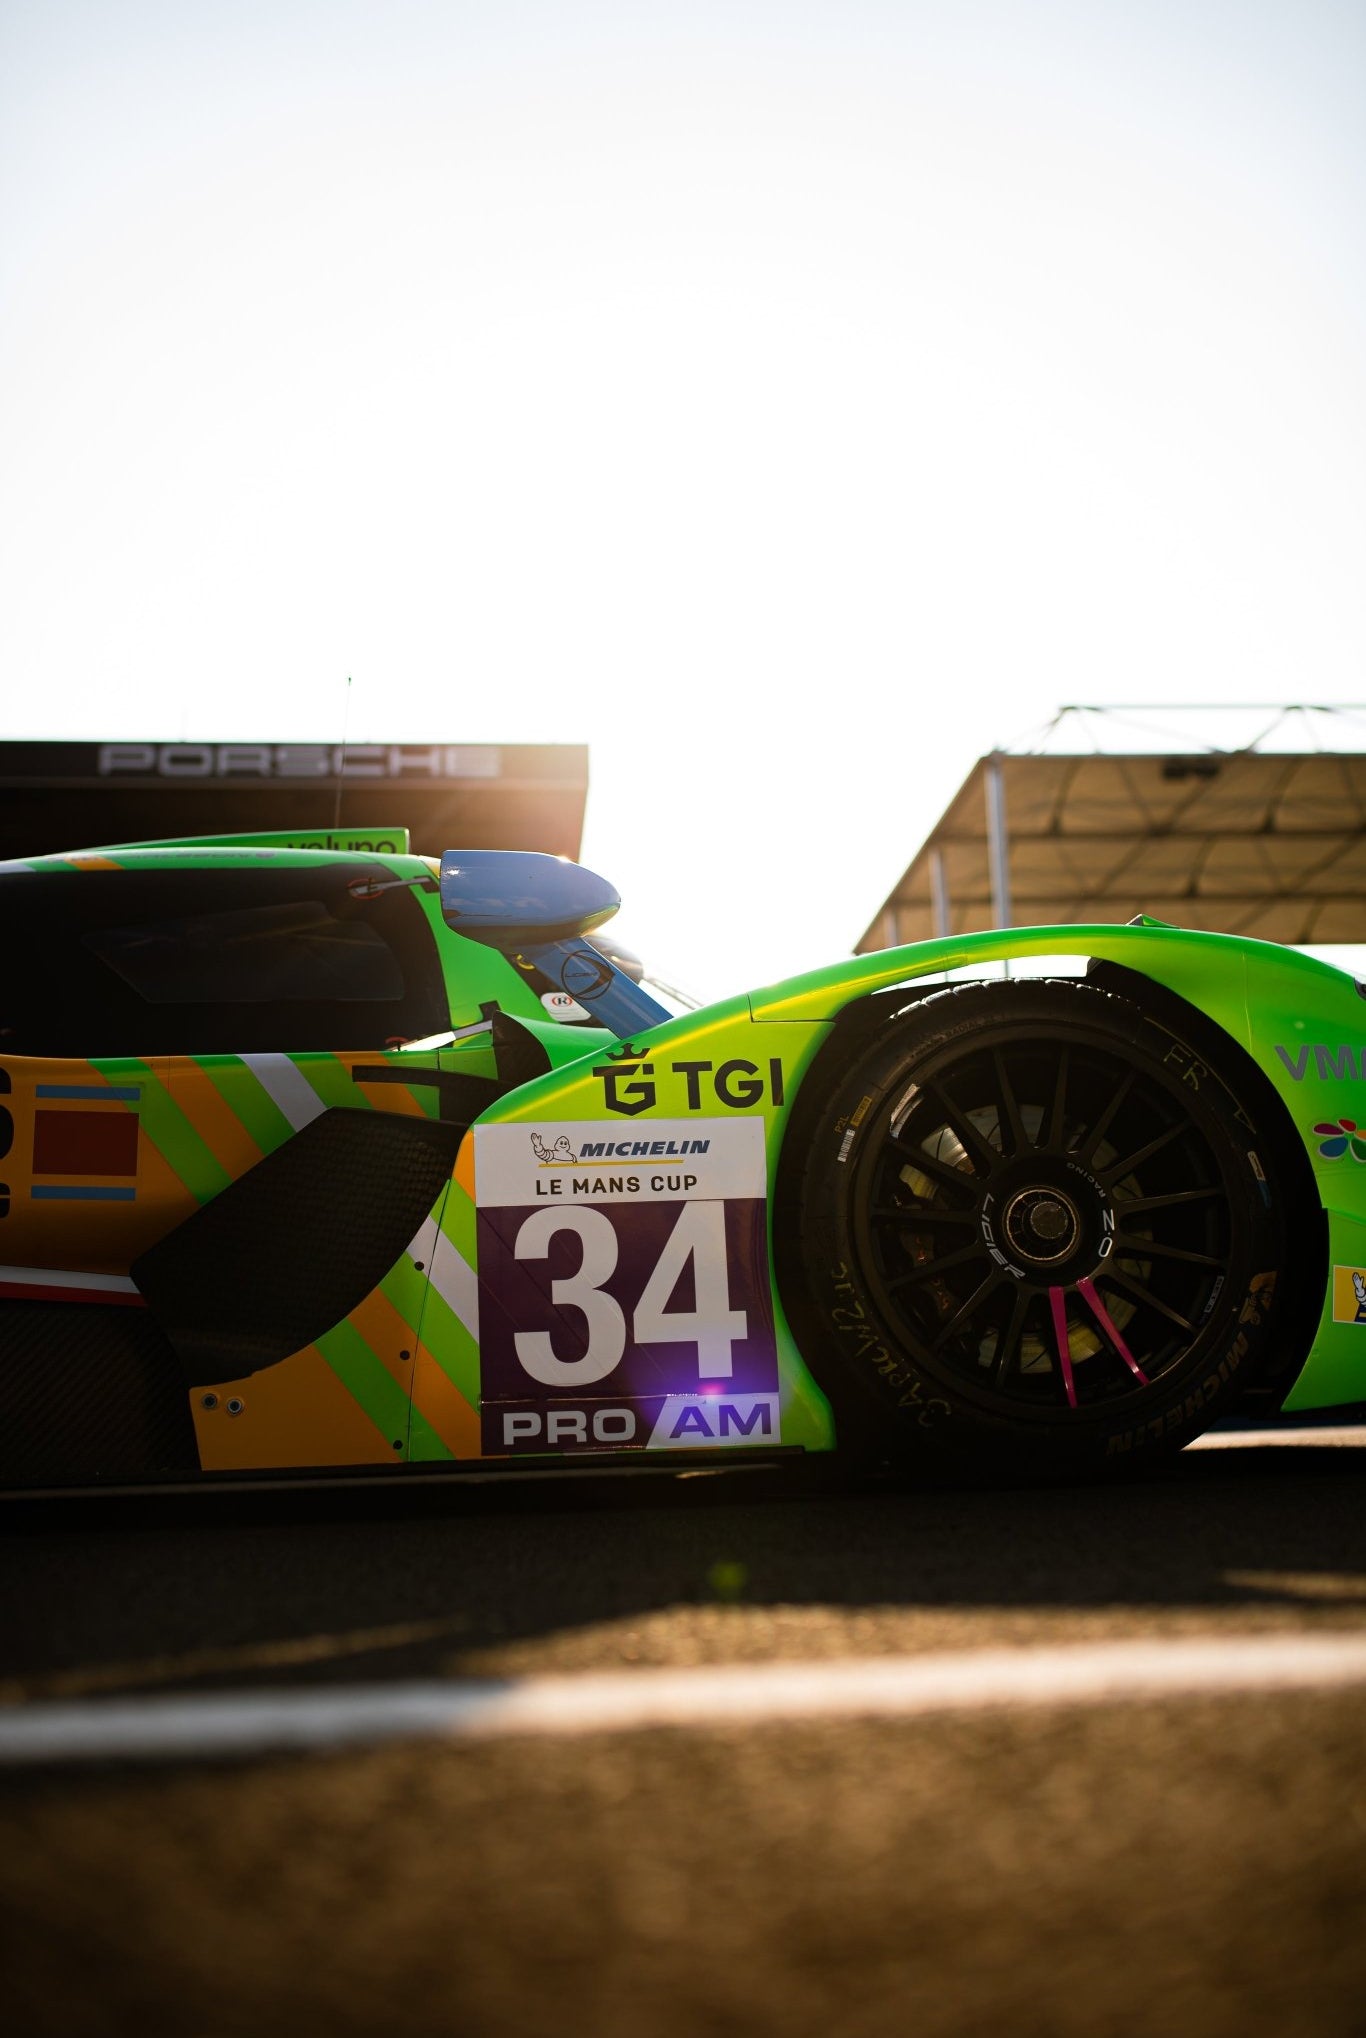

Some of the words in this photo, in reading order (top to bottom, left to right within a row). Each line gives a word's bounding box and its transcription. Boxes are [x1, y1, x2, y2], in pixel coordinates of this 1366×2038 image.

[100, 744, 499, 777] PORSCHE
[671, 1057, 785, 1110] TGI
[1163, 1042, 1208, 1091] FR
[1274, 1044, 1366, 1081] VM
[579, 1139, 711, 1158] MICHELIN
[536, 1178, 563, 1196] LE
[573, 1176, 641, 1194] MANS
[650, 1174, 698, 1192] CUP
[1066, 1161, 1107, 1198] RACING
[982, 1192, 1027, 1279] LIGIER
[514, 1199, 748, 1388] 34
[1104, 1329, 1250, 1457] MICHELIN
[503, 1408, 636, 1446] PRO
[669, 1403, 772, 1439] AM
